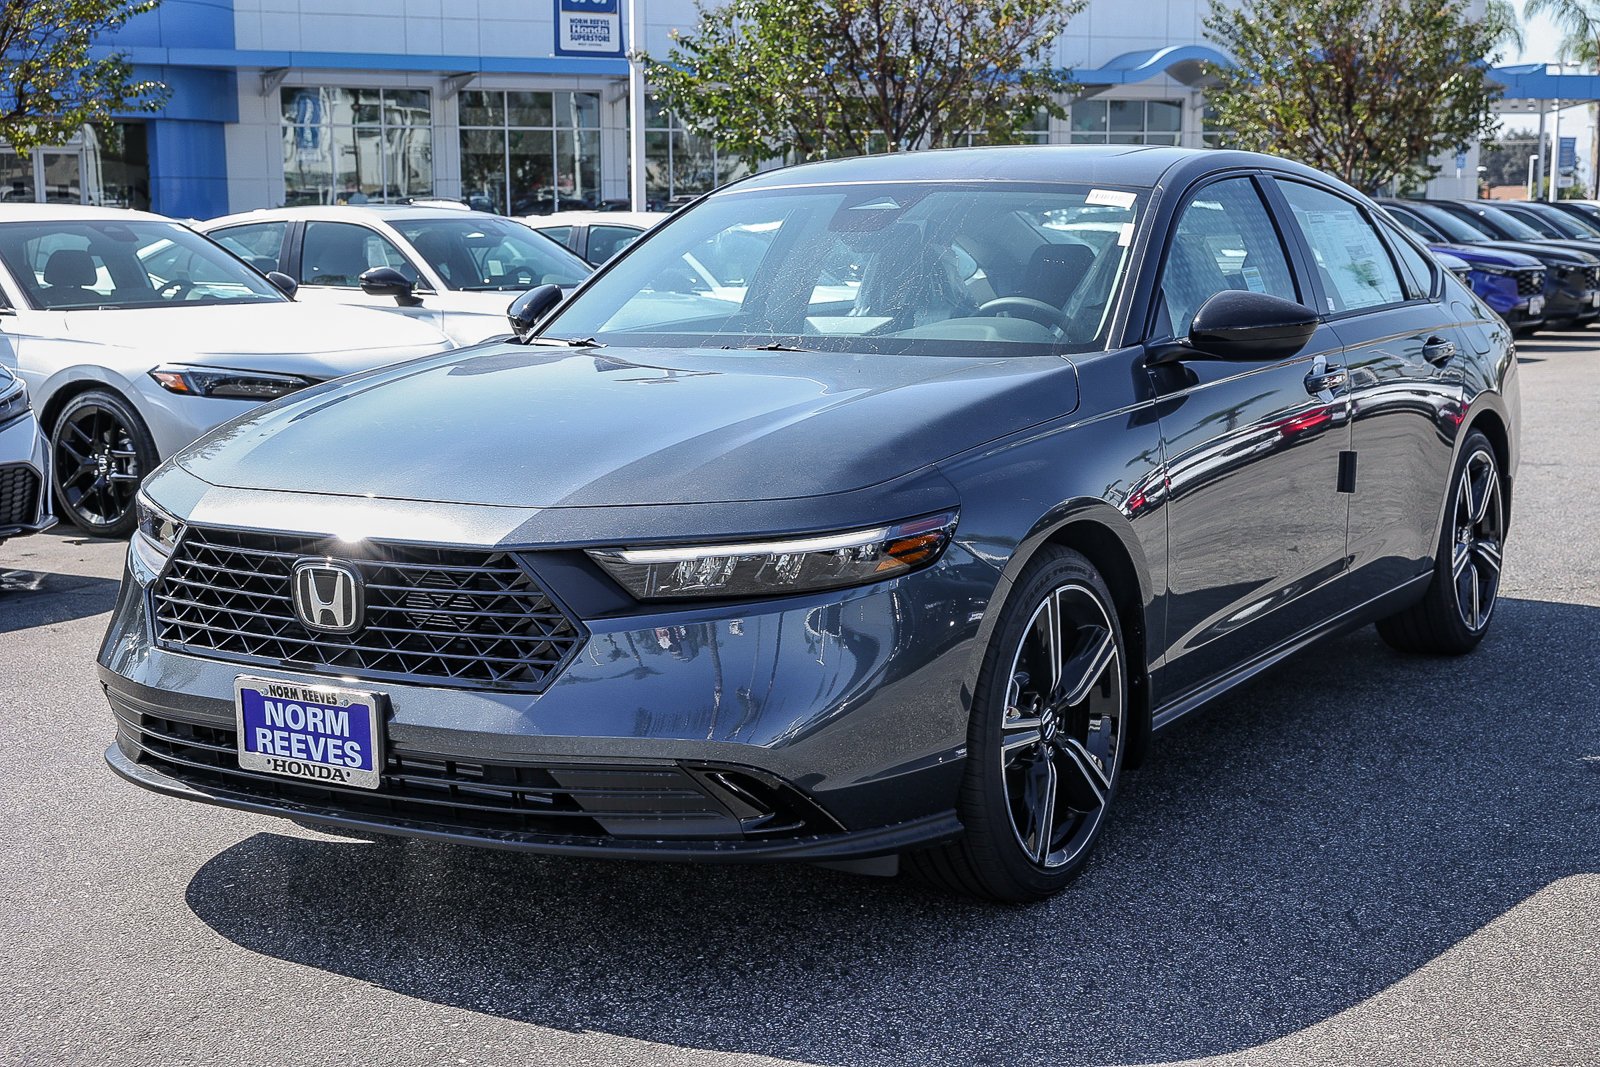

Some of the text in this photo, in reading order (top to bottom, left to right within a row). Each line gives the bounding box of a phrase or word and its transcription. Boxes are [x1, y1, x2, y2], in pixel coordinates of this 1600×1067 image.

[570, 34, 610, 42] SUPERSTORE
[572, 25, 608, 34] Honda
[268, 685, 338, 705] NORM REEVES
[264, 700, 350, 737] NORM
[255, 727, 363, 768] REEVES
[271, 758, 347, 782] HONDA
